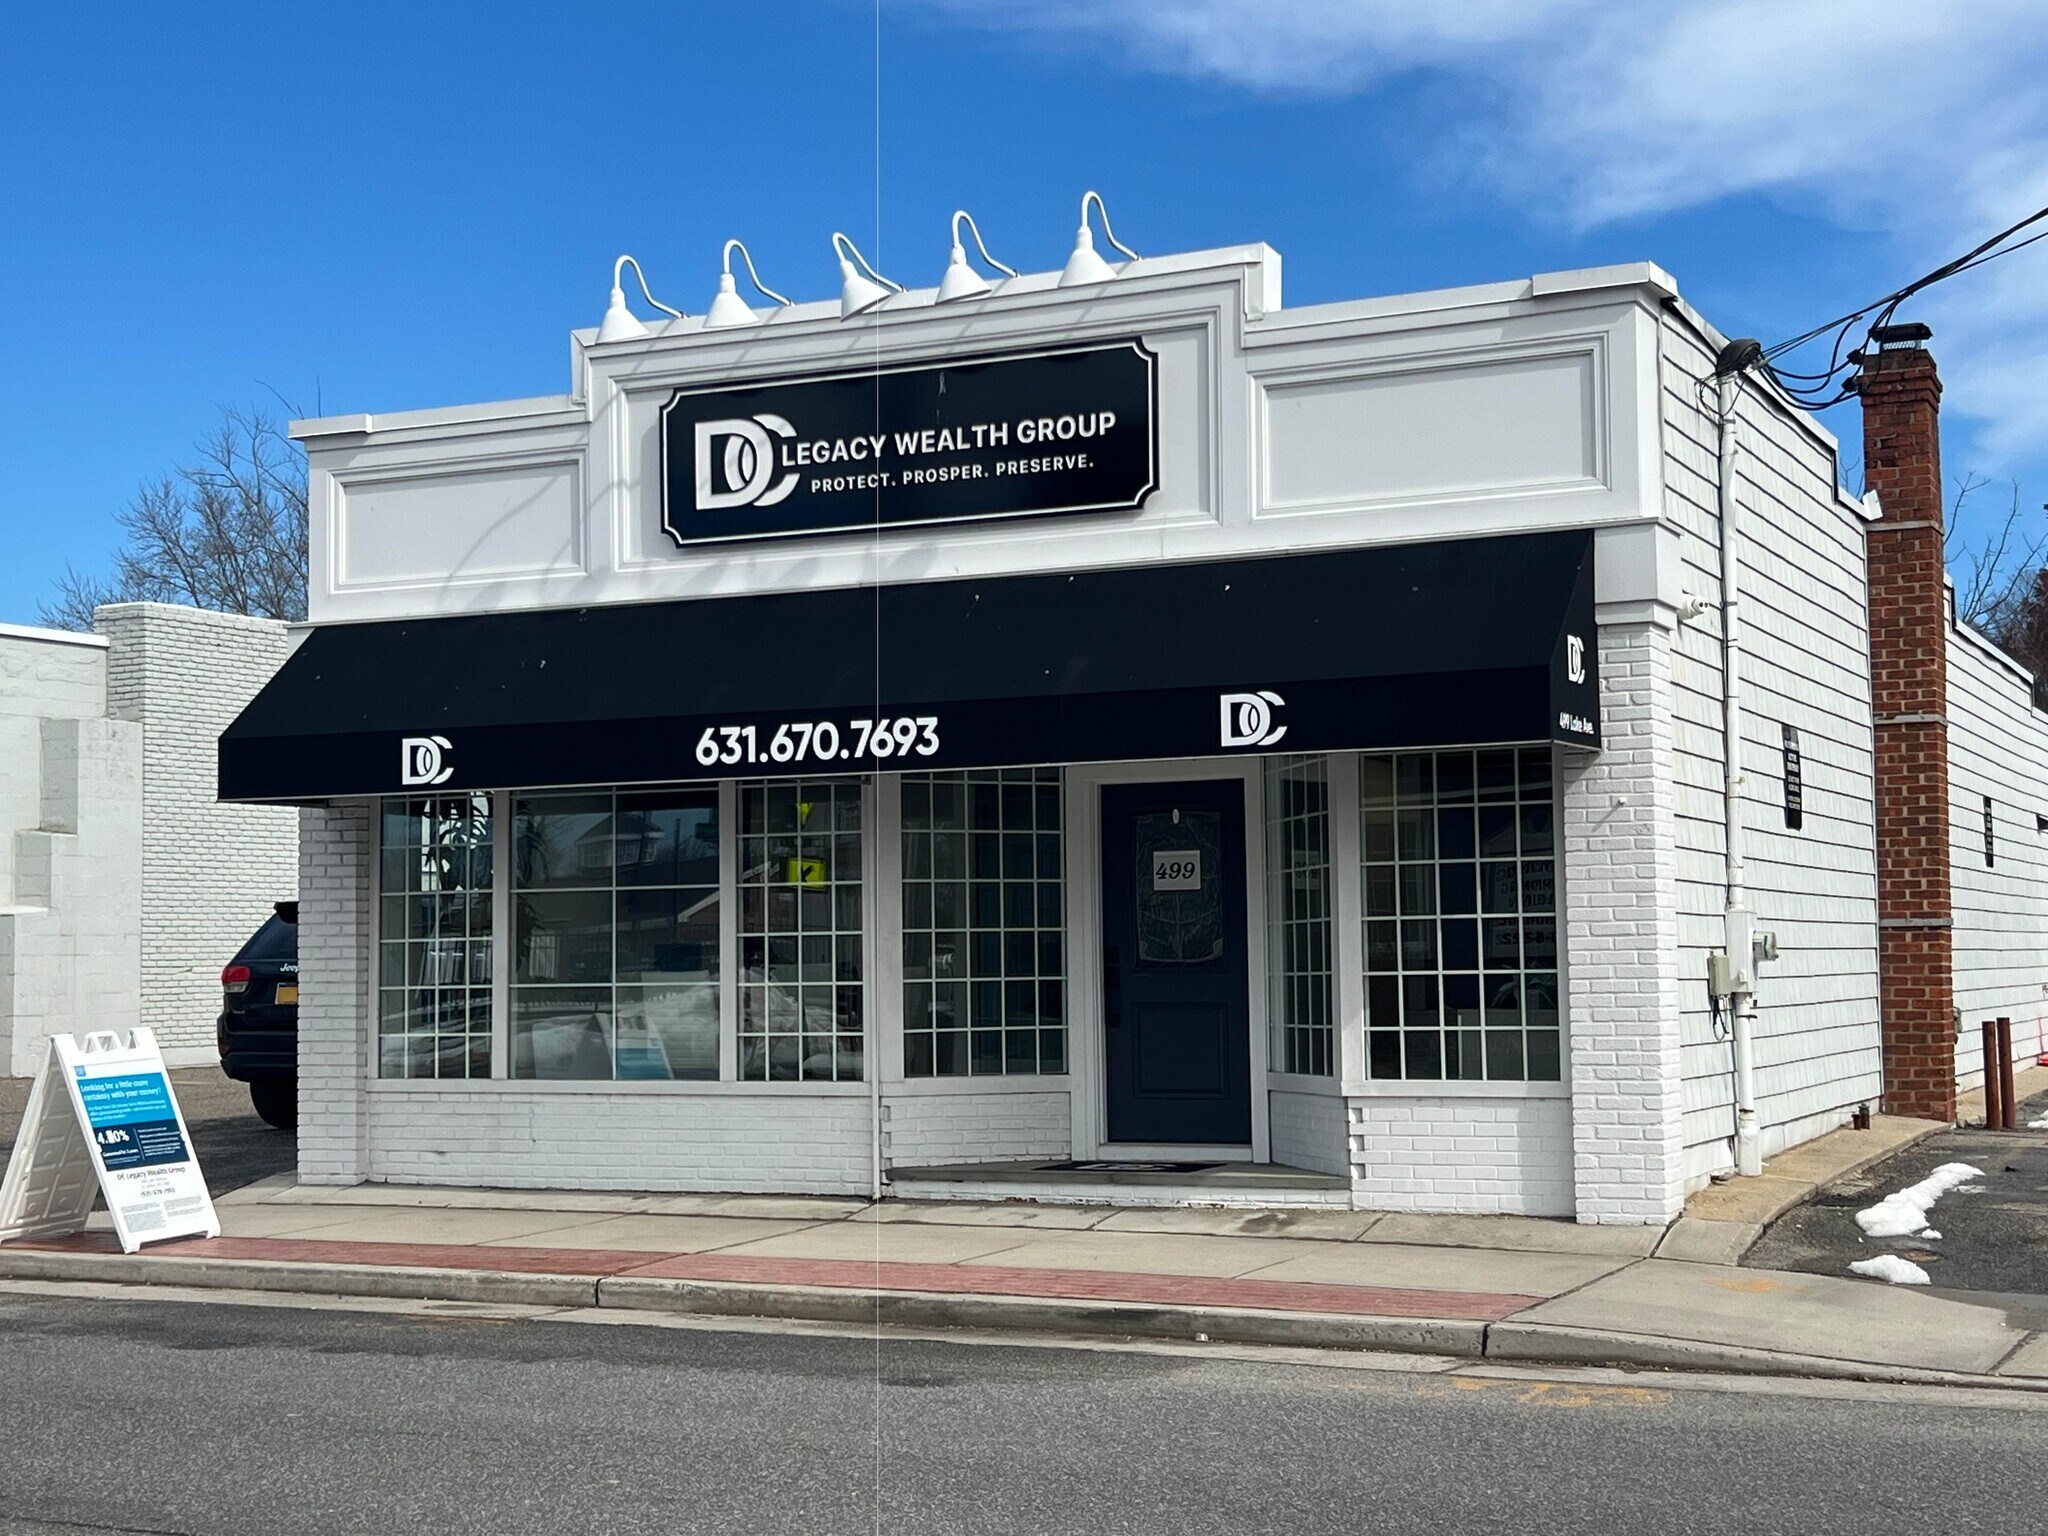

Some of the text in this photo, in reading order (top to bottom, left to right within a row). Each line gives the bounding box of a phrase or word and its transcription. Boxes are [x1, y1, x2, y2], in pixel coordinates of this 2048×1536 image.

[782, 411, 1116, 466] LEGACY WEALTH GROUP
[811, 453, 1094, 493] PROTECT. PROSPER. PRESERVE.
[696, 716, 939, 766] 631.670.7693
[1155, 861, 1196, 880] 499
